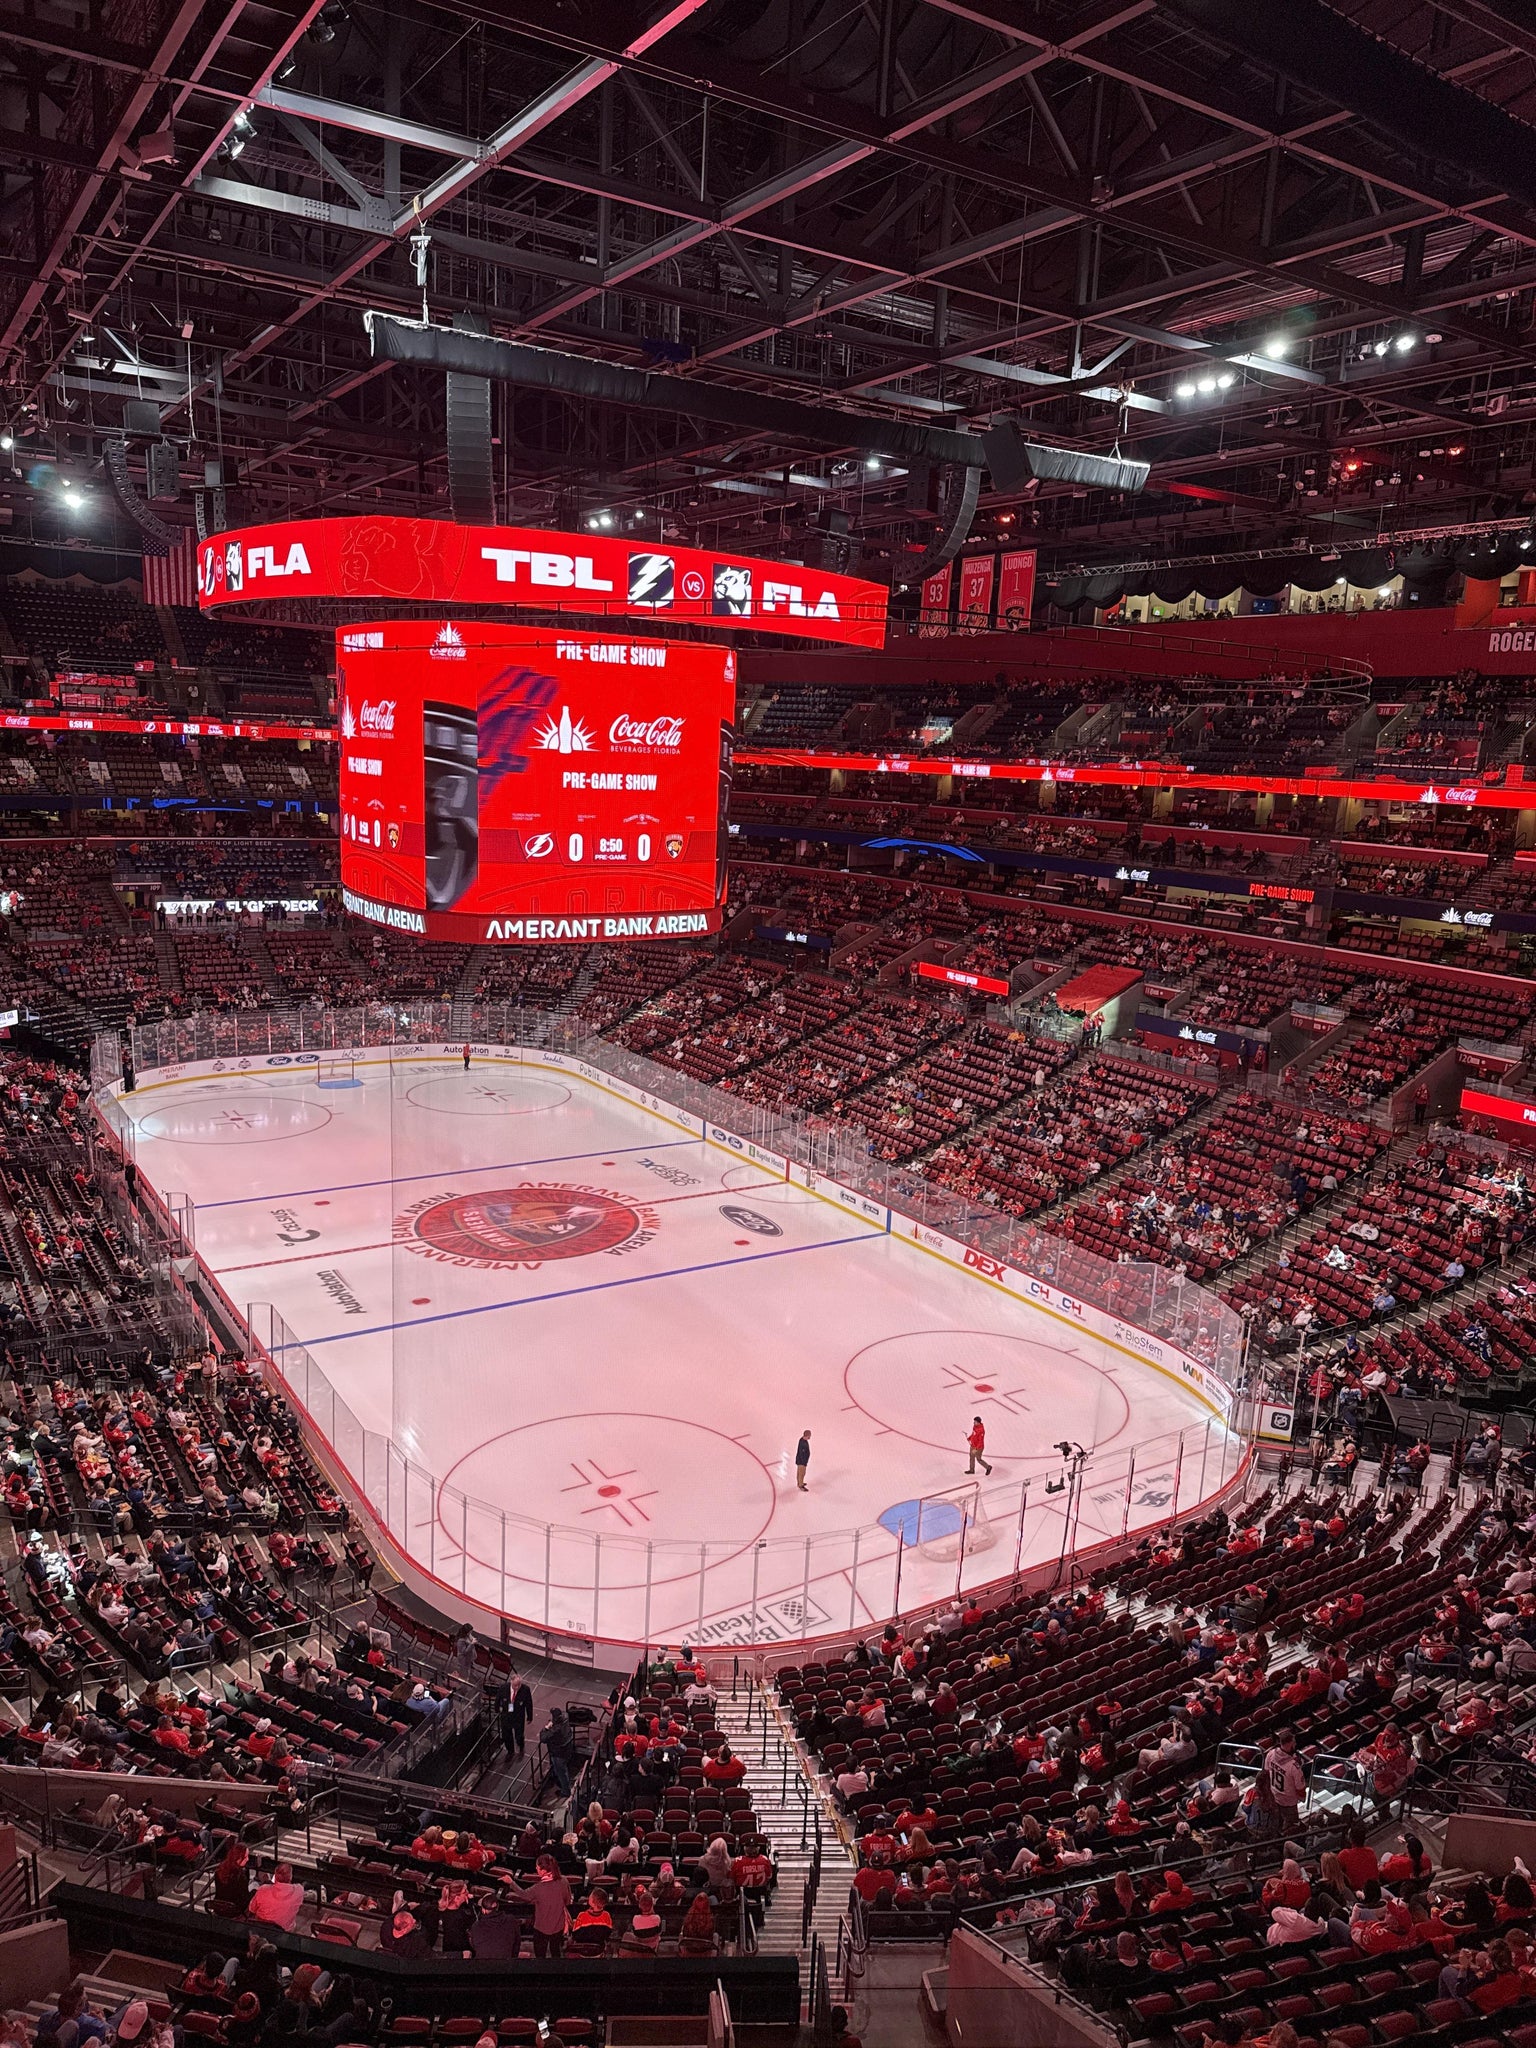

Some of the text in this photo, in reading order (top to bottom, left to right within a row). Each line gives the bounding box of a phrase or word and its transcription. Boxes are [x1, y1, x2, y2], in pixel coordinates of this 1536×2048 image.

[248, 543, 312, 578] FLA
[481, 547, 613, 591] TBL
[1004, 556, 1033, 571] LUONGO
[687, 580, 701, 593] VS
[970, 578, 984, 598] 37
[1013, 572, 1019, 592] 1
[762, 581, 842, 622] FLA
[929, 584, 943, 603] 93
[1489, 631, 1536, 652] ROGE
[556, 639, 667, 668] PRE-GAME SHOW
[5, 716, 30, 727] Coca-Cola
[83, 720, 94, 729] PM
[361, 699, 397, 730] Coca-Cola
[165, 723, 171, 733] 0
[235, 725, 240, 736] 0
[608, 713, 687, 746] Coca-Cola
[610, 745, 681, 755] BEVERAGES FLORIDA
[891, 761, 910, 770] Coca-Cola
[976, 765, 991, 776] SHOW
[1055, 768, 1075, 779] Coca-Cola
[562, 772, 658, 791] PRE-GAME SHOW
[1445, 788, 1478, 801] Coca-Cola
[374, 819, 381, 847] 0
[568, 833, 583, 862] 0
[600, 838, 623, 852] 8:50
[638, 833, 651, 862] 0
[1249, 883, 1315, 902] PRE-GAME SHOW
[364, 900, 386, 924] BANK
[387, 908, 427, 933] ARENA
[1464, 911, 1495, 925] Coca-Cola
[486, 914, 708, 940] AMERANT BANK ARENA
[443, 1046, 489, 1054] Autoation
[158, 1065, 187, 1075] AMERANT
[580, 1063, 600, 1081] Publix
[518, 1181, 639, 1203] AMERANT
[410, 1191, 462, 1215] ARENA
[270, 1208, 302, 1232] CELSIUS
[391, 1215, 414, 1239] BANK
[636, 1207, 661, 1229] BANK
[604, 1230, 658, 1256] ARENA
[924, 1232, 944, 1247] Coca-Cola
[404, 1244, 543, 1271] AMERANT
[963, 1249, 1007, 1282] DEX
[316, 1269, 367, 1314] AutoNation
[1031, 1282, 1049, 1299] CH
[1062, 1297, 1082, 1315] CH
[1126, 1329, 1163, 1357] BioStem
[1182, 1361, 1203, 1385] WM
[1271, 1768, 1285, 1792] 19
